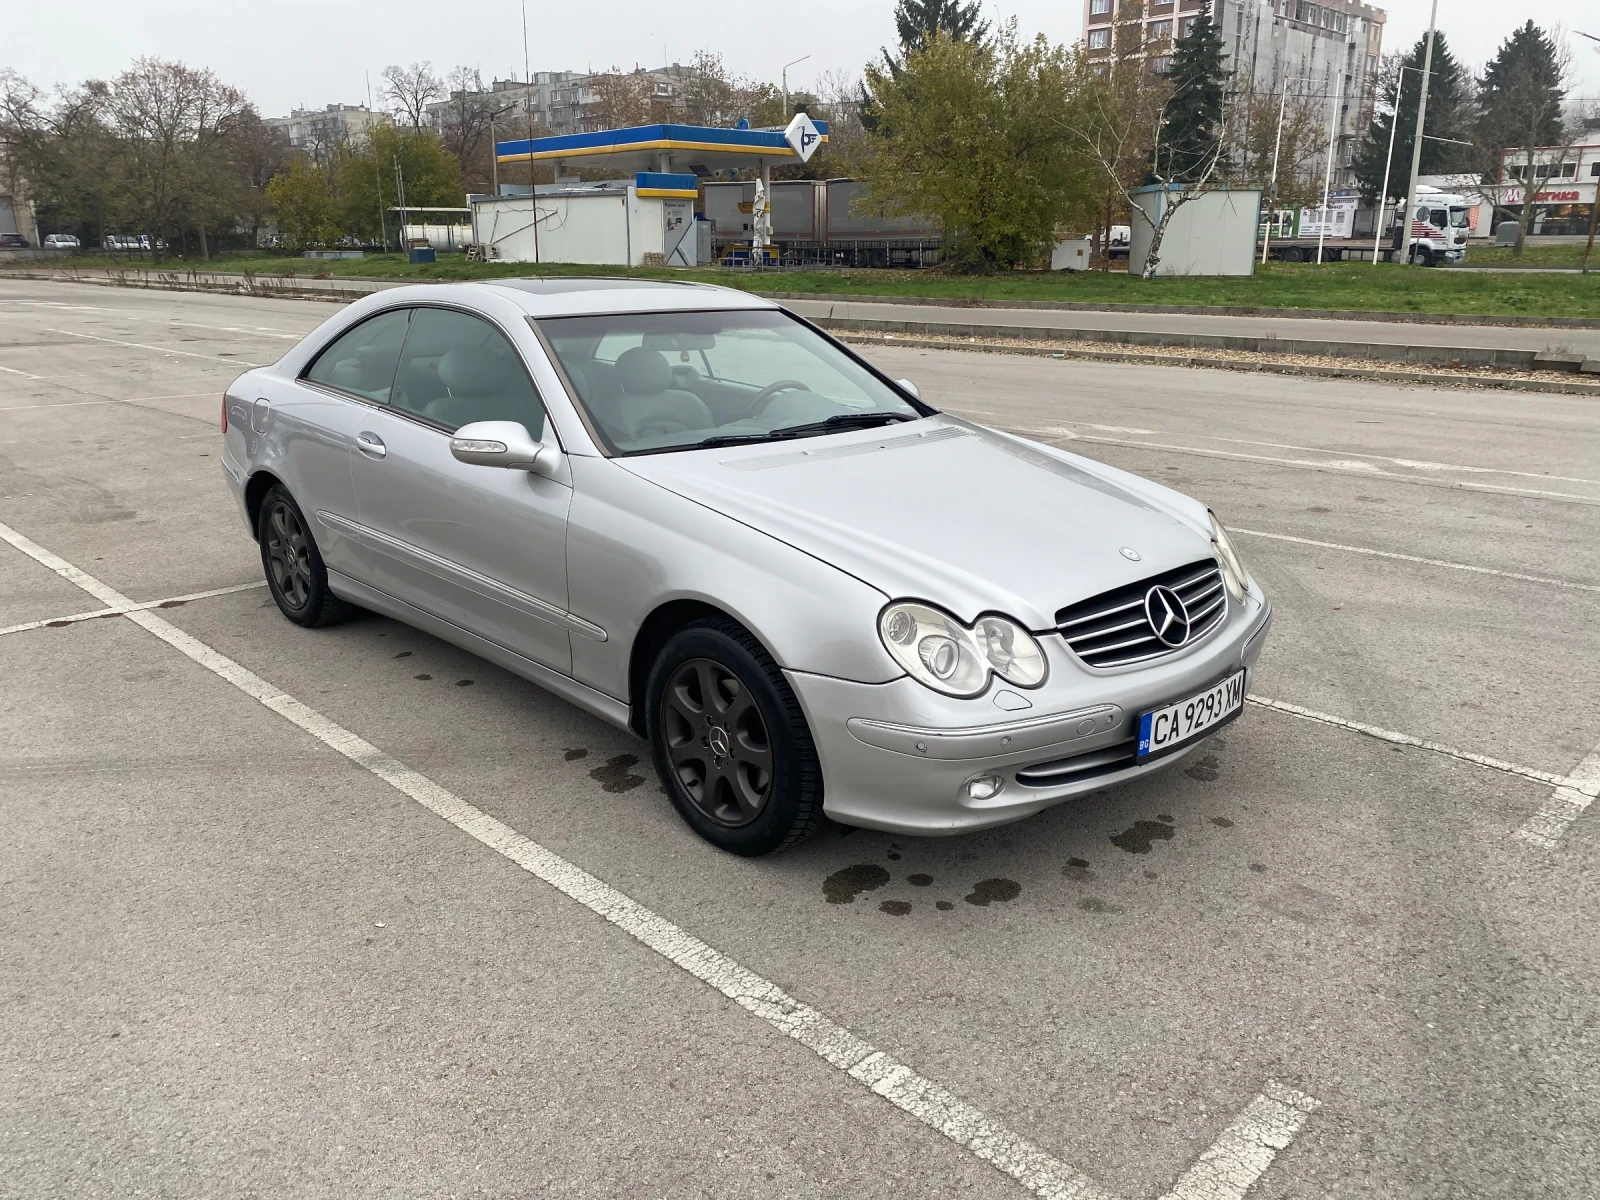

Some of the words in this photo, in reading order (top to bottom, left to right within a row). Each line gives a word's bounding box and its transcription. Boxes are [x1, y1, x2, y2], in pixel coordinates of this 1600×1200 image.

[1154, 709, 1180, 745] CA
[1185, 688, 1223, 734] 9293
[1224, 675, 1242, 712] XM
[1139, 739, 1150, 750] BG
